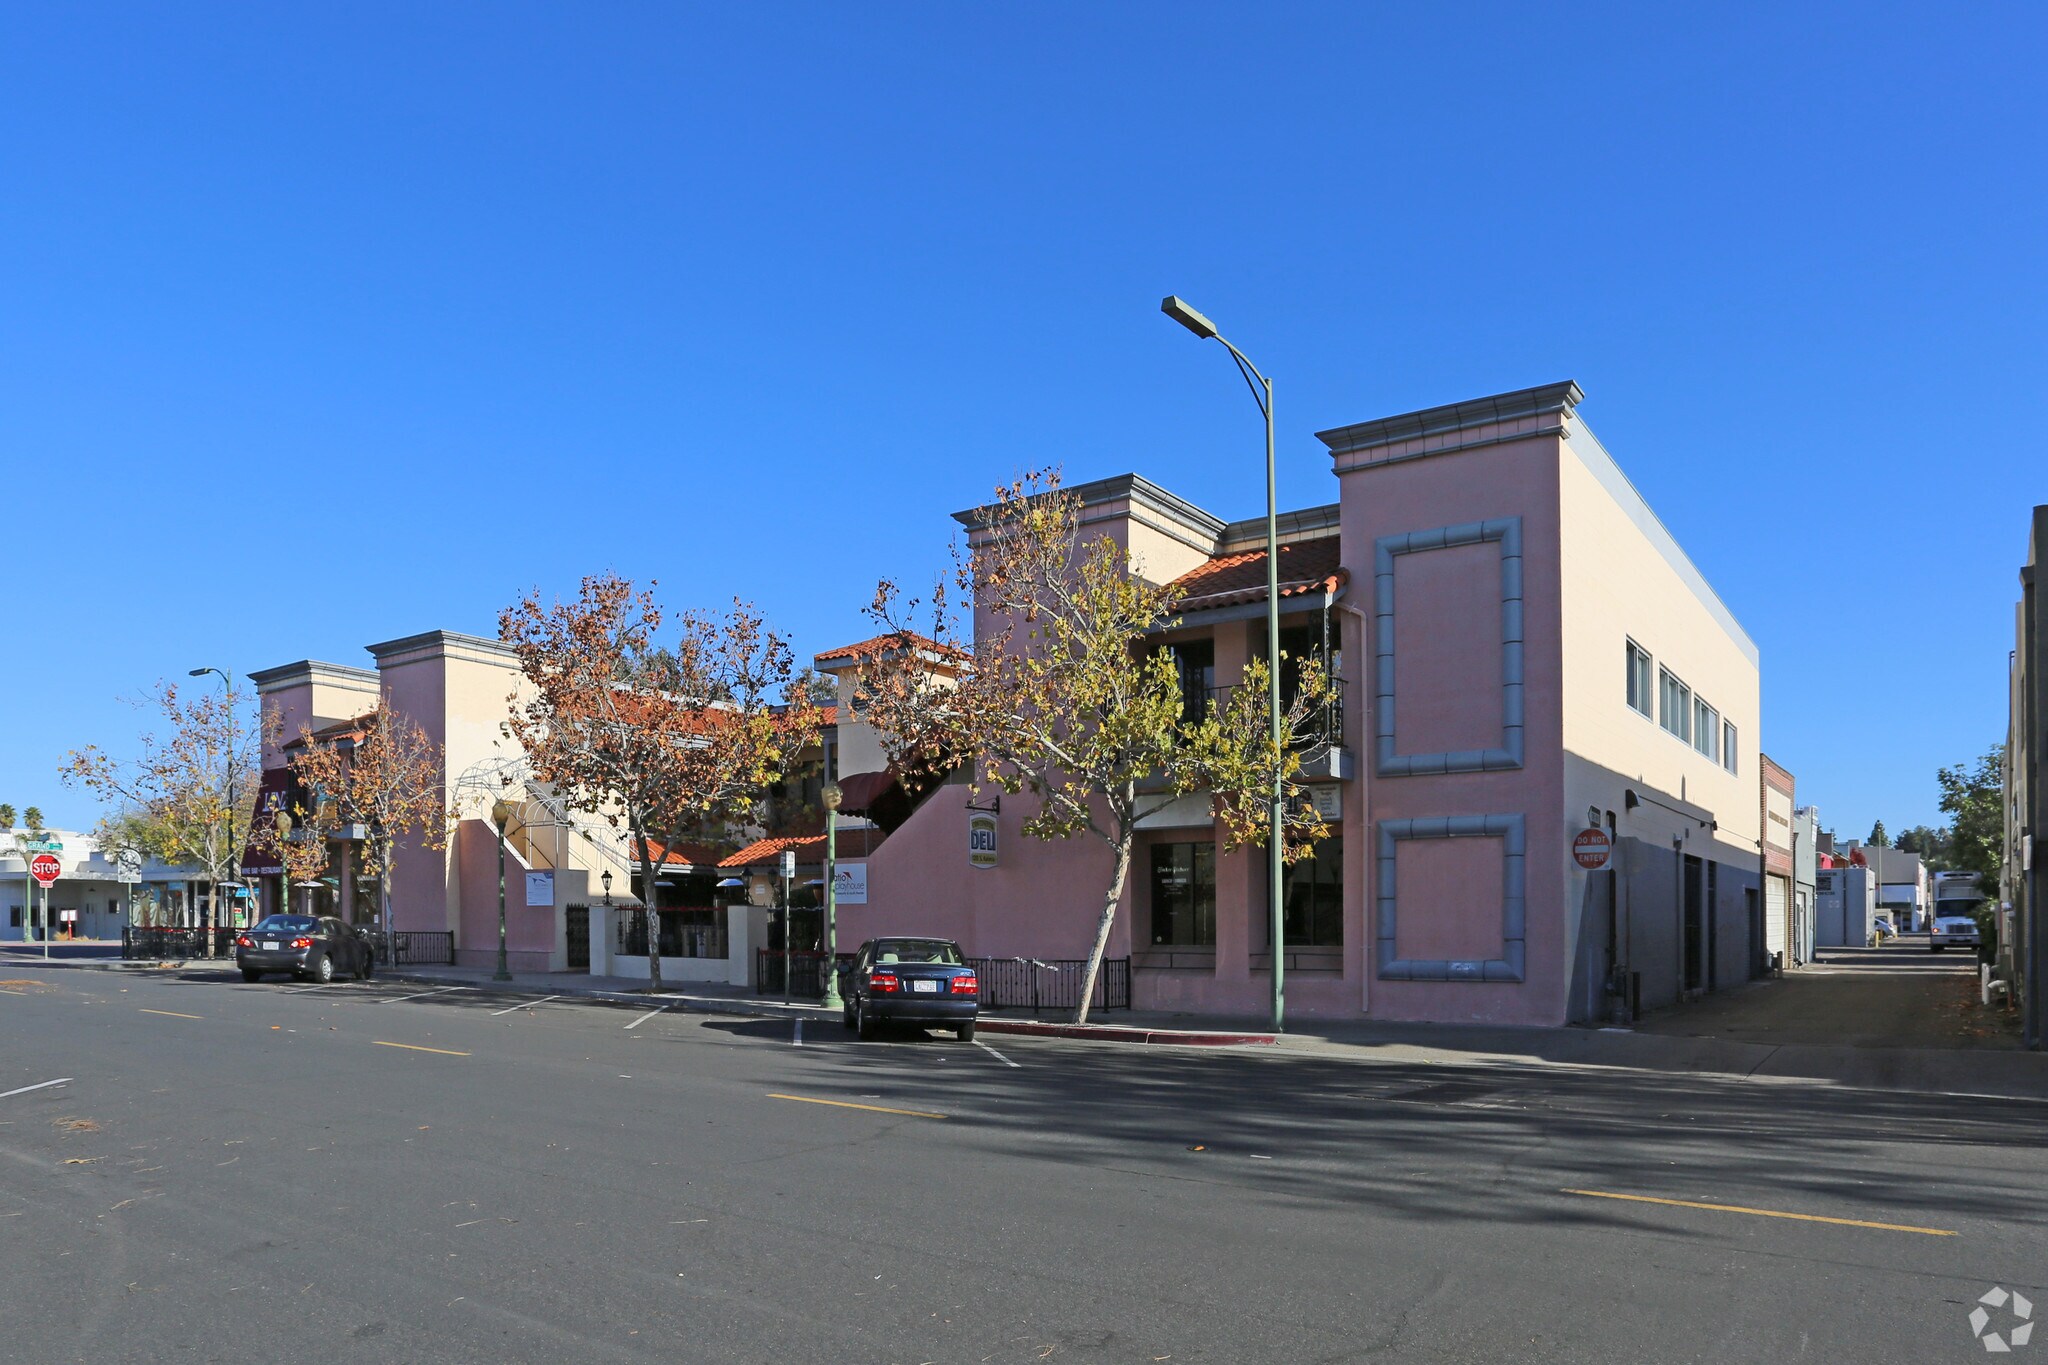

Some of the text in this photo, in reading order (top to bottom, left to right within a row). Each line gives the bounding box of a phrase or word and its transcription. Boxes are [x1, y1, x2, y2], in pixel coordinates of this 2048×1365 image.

[970, 830, 996, 851] DELI
[1577, 836, 1606, 844] DO NOT
[27, 841, 50, 850] GRAND
[1578, 854, 1604, 862] ENTER
[33, 862, 60, 875] STOP
